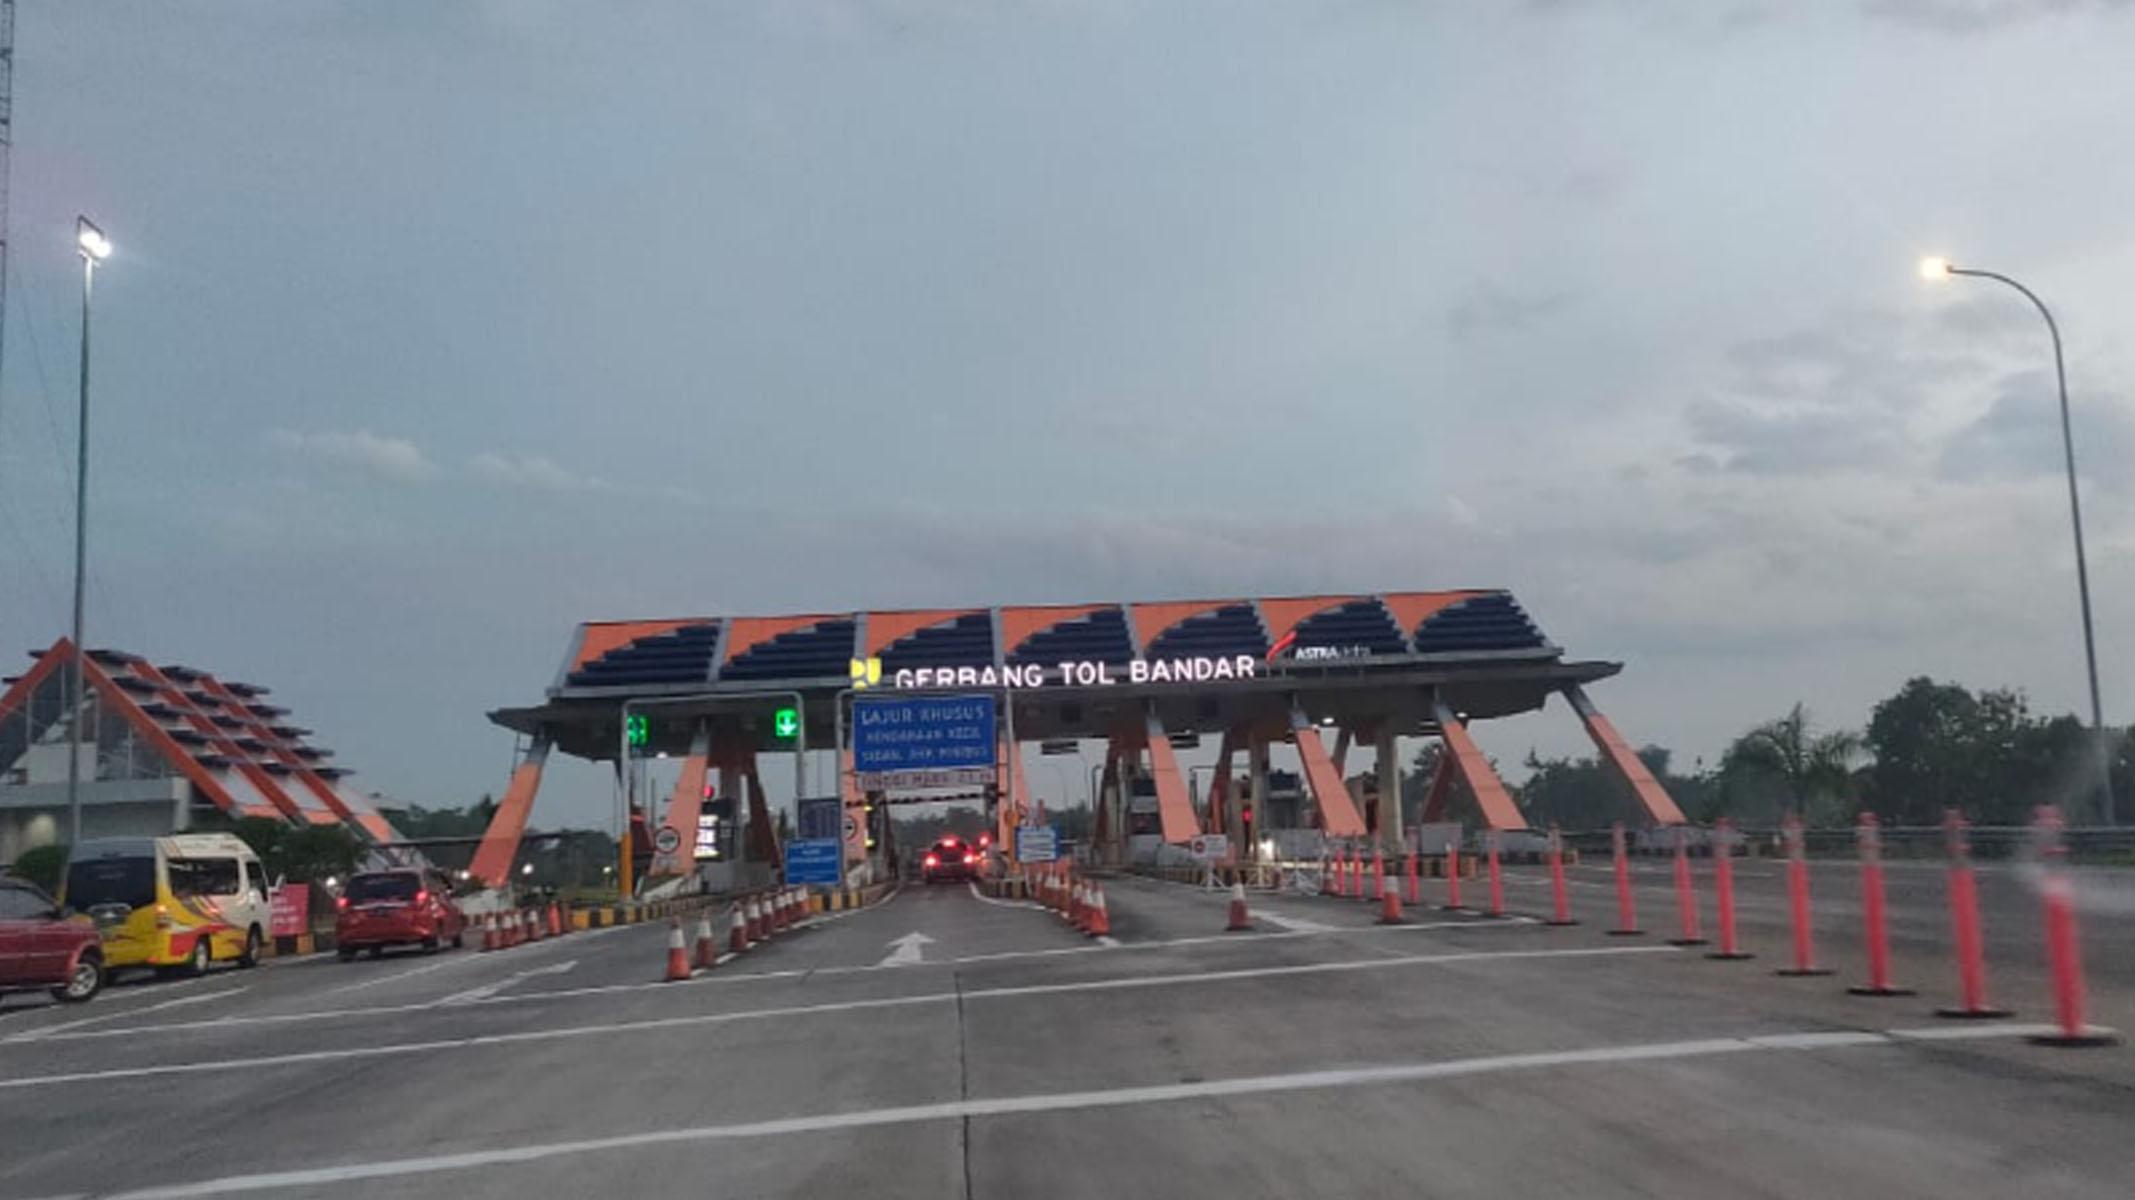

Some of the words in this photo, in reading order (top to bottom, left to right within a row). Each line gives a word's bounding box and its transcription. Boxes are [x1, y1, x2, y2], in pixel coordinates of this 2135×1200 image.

[1295, 646, 1340, 660] ASTRA
[895, 664, 1043, 689] GERBANG
[1059, 661, 1115, 685] TOL
[1130, 655, 1255, 683] BANDAR
[861, 708, 912, 725] LAJUR
[920, 705, 984, 722] KHUSUS
